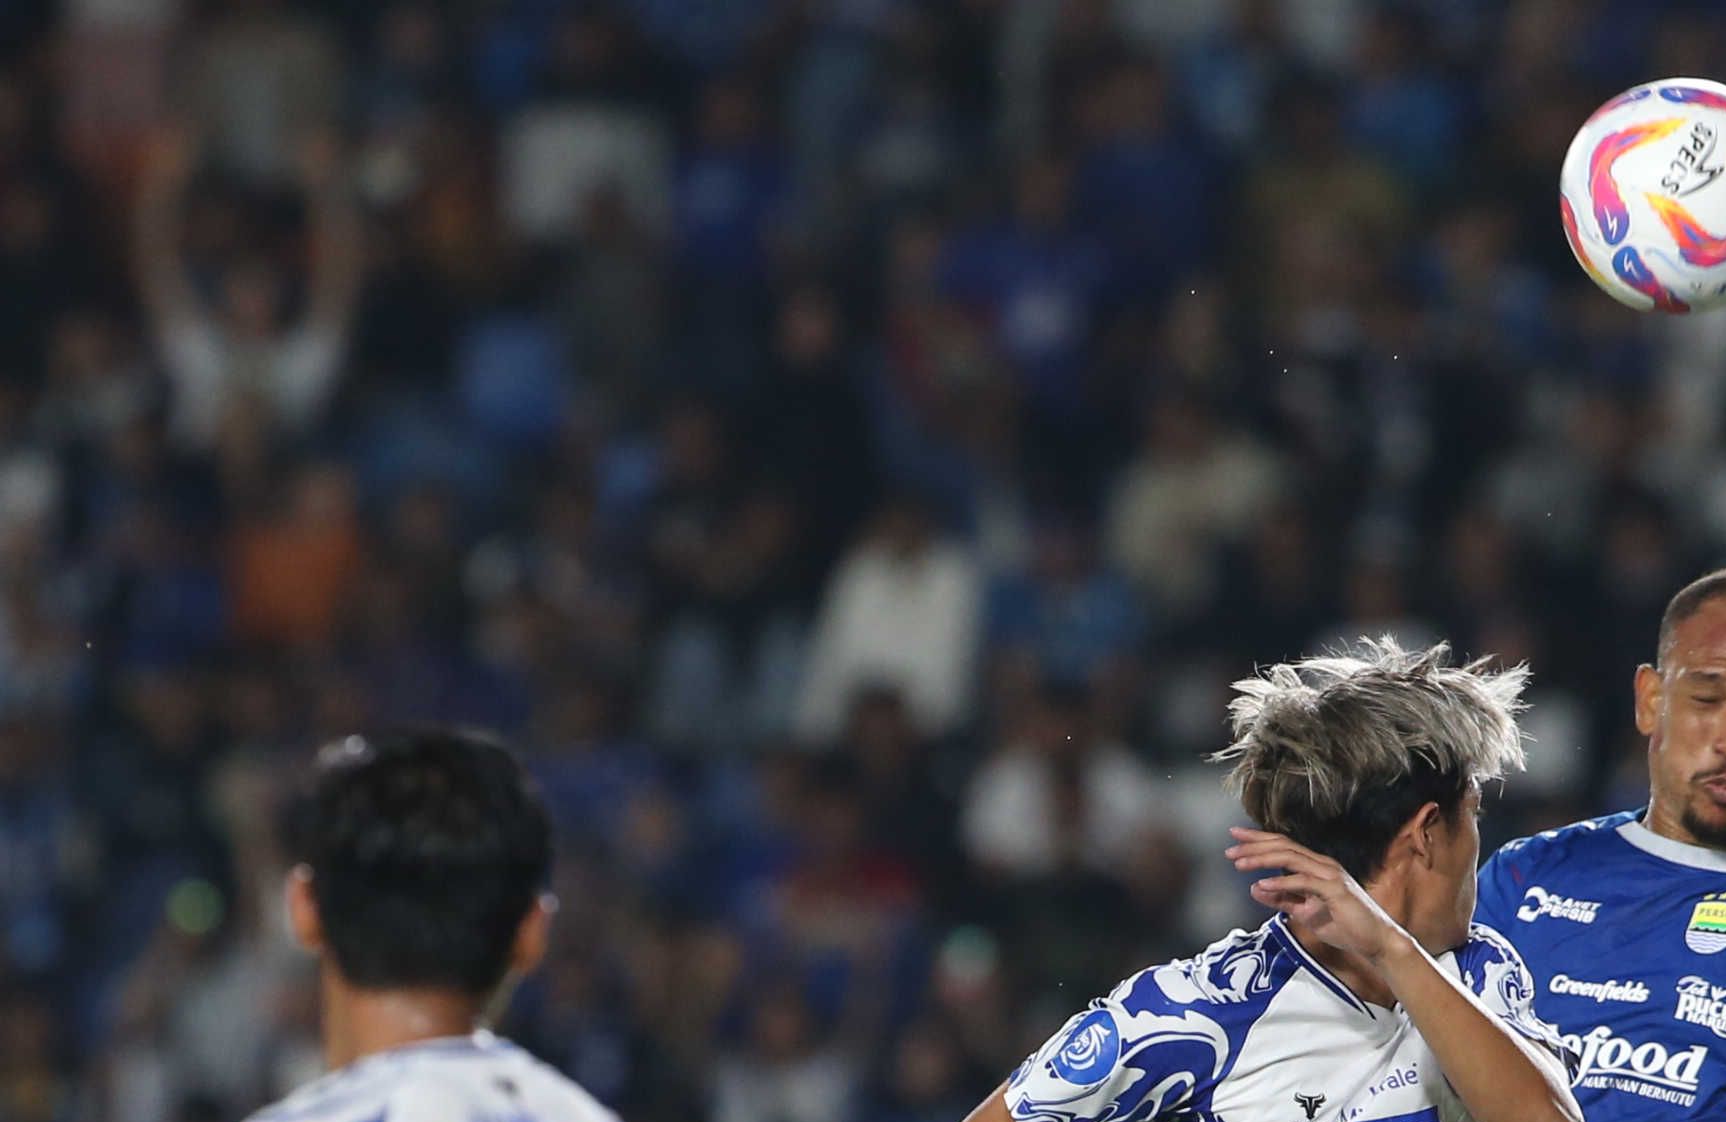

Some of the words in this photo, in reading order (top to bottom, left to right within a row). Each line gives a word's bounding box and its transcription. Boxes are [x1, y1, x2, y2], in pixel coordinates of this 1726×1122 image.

[1660, 122, 1713, 195] SPECS
[1540, 903, 1597, 924] PERSIB
[1549, 974, 1650, 1005] Greenfields
[1638, 1083, 1696, 1107] BERMUTU
